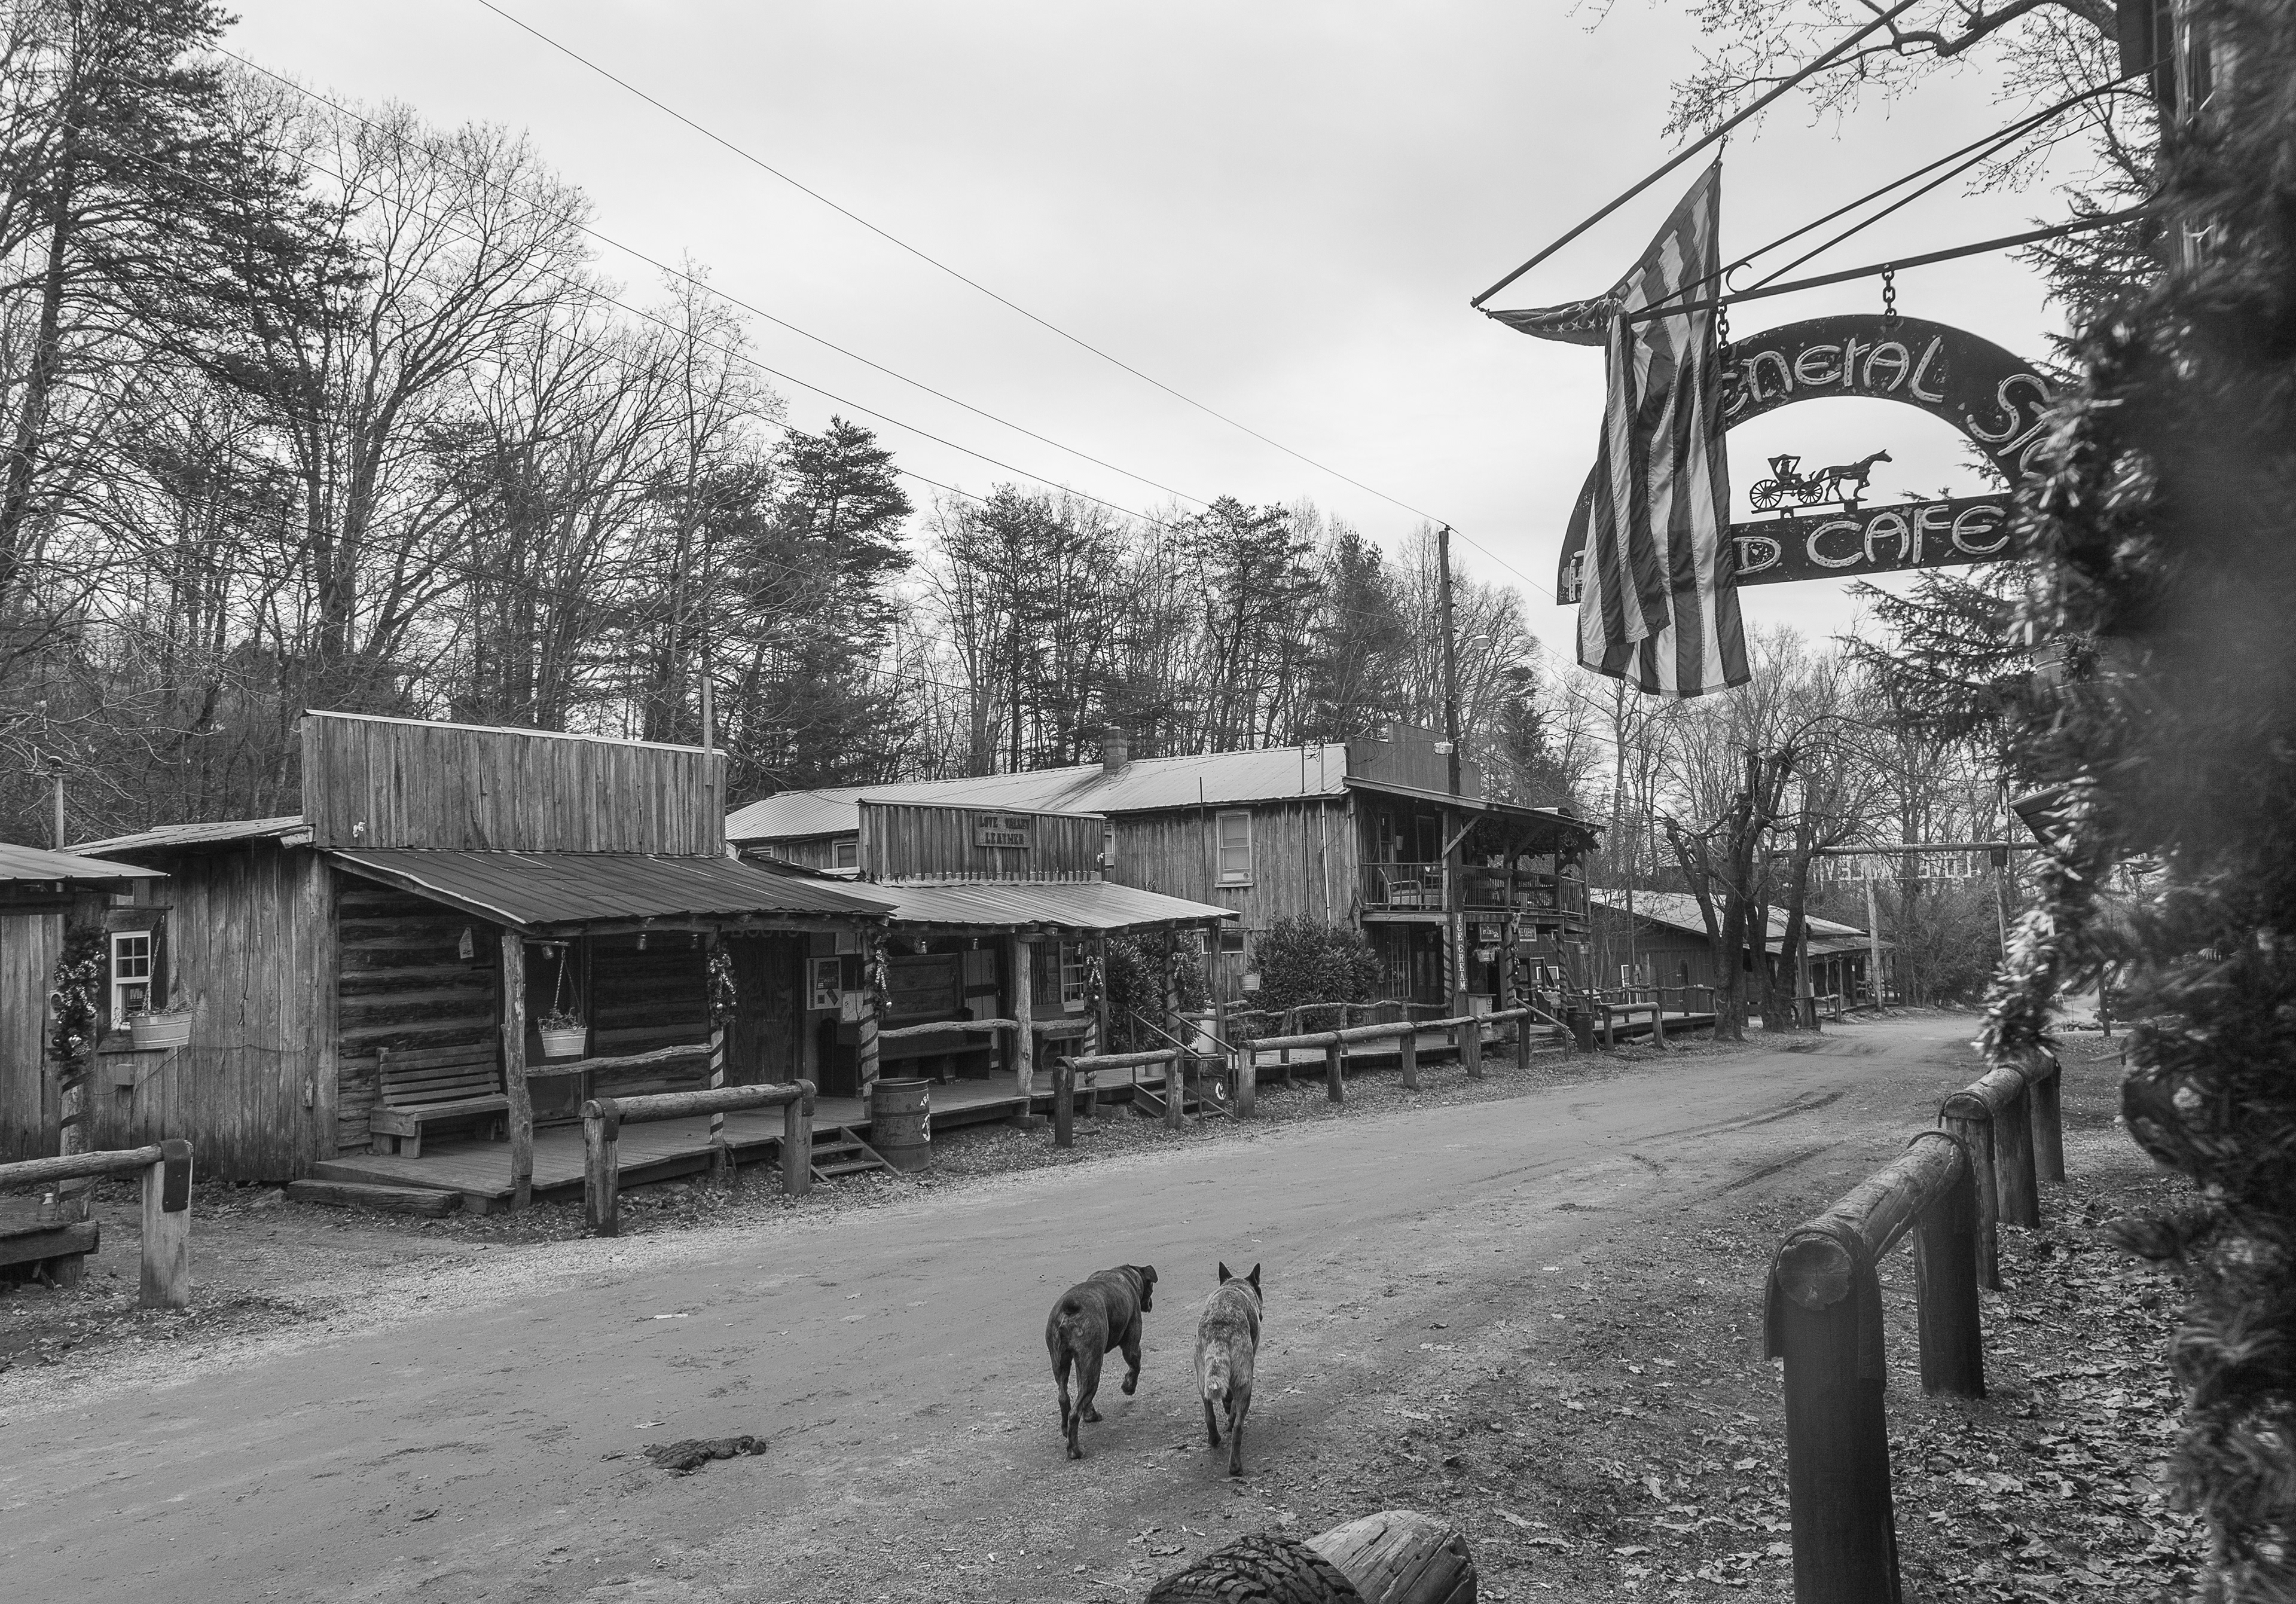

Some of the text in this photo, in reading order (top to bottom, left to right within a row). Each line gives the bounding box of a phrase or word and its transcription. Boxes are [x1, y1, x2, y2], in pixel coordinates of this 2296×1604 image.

[1806, 505, 2010, 569] CAFE
[979, 816, 1030, 830] LOVE VALLEY
[985, 832, 1024, 844] LEATHER
[1458, 944, 1466, 990] CREAM
